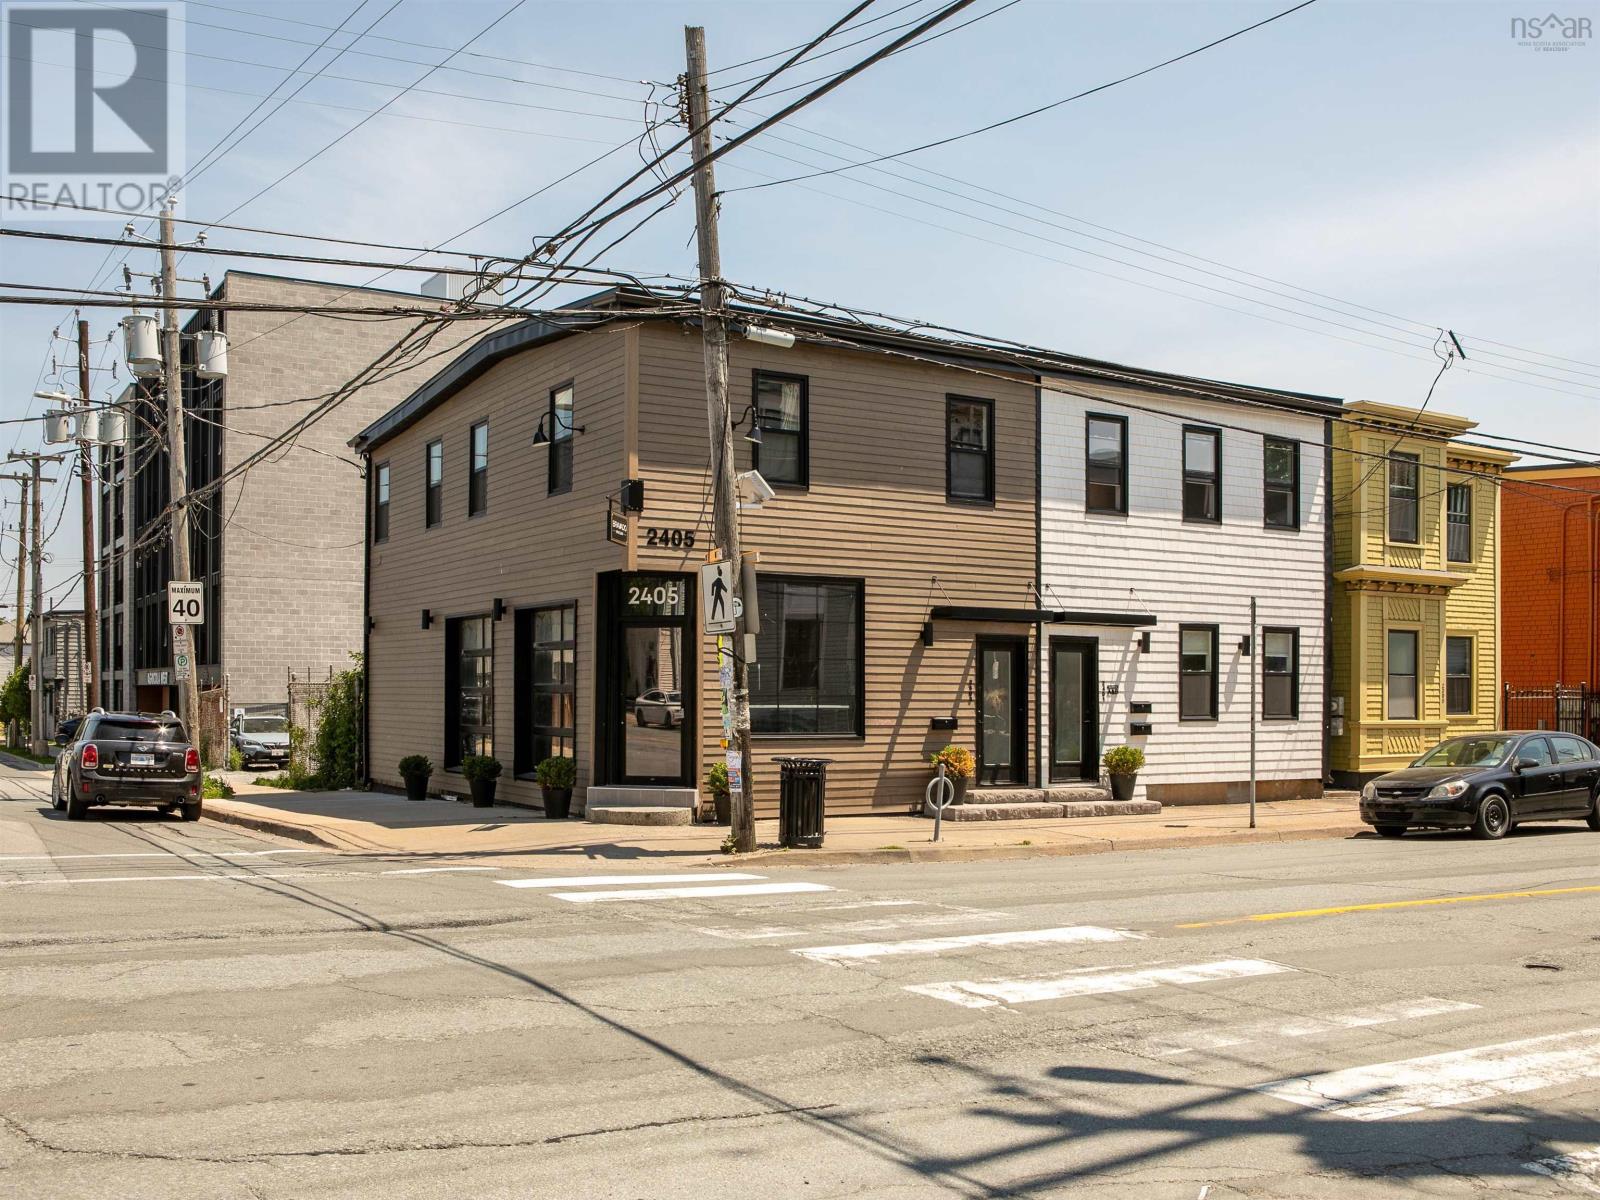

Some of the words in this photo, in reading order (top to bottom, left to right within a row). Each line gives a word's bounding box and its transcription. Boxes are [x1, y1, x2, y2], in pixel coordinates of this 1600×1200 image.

[646, 528, 695, 548] 2405
[171, 586, 201, 594] MAXIMUM
[628, 586, 679, 605] 2405
[172, 599, 200, 617] 40
